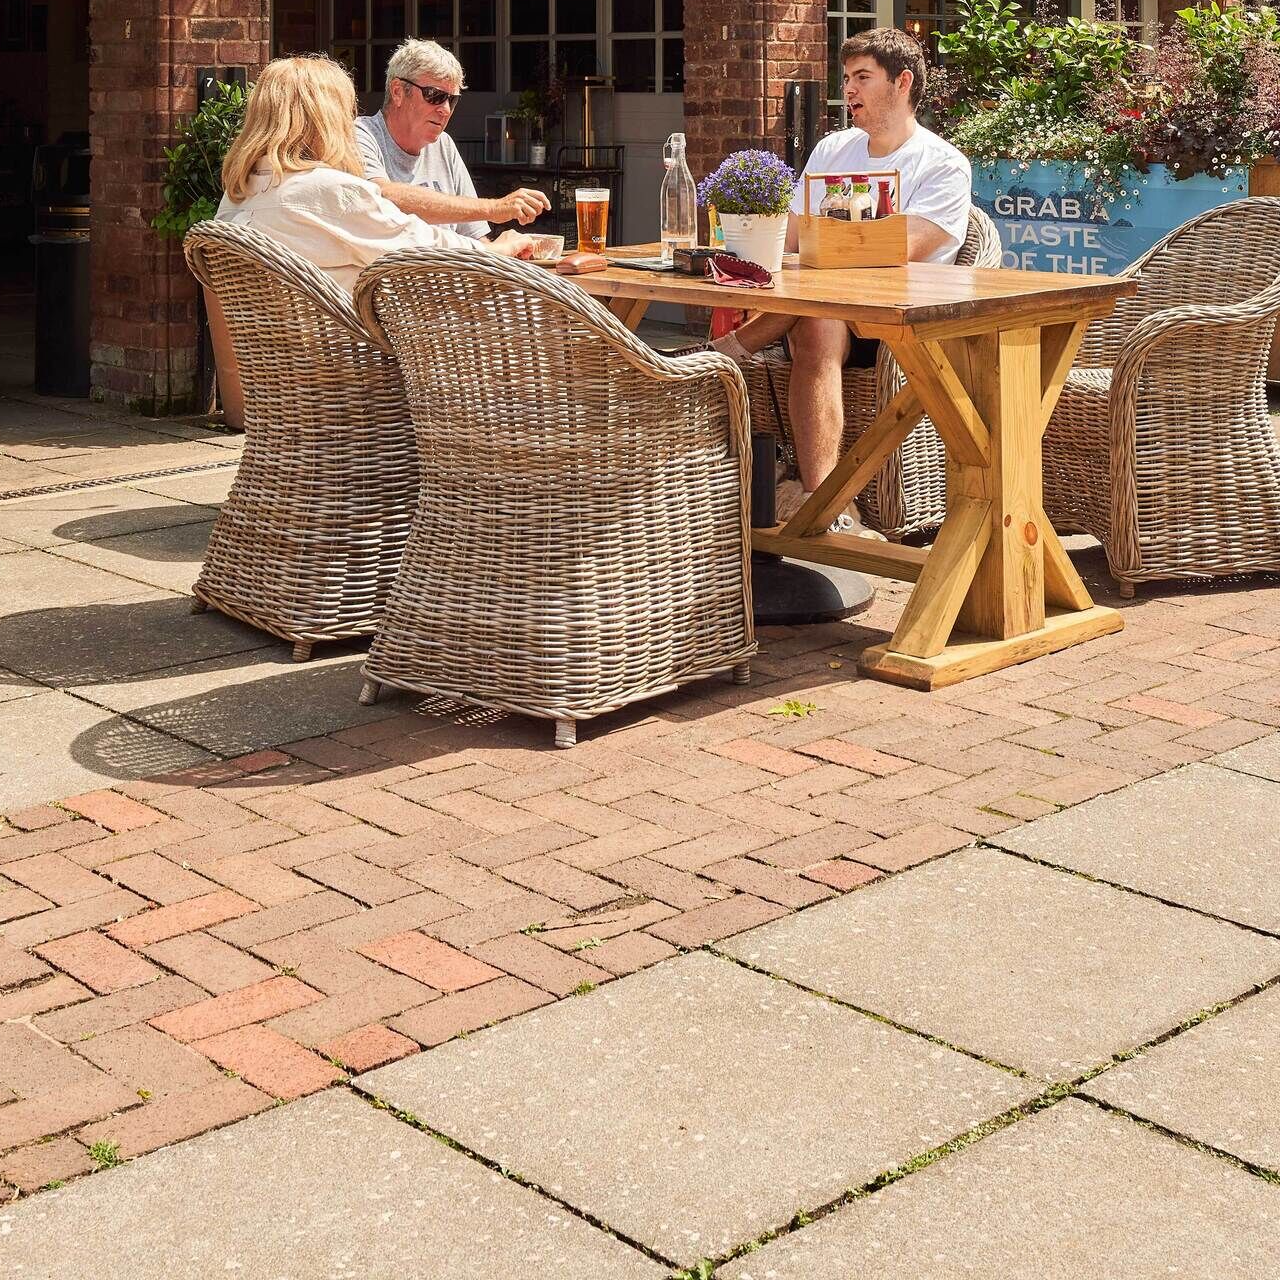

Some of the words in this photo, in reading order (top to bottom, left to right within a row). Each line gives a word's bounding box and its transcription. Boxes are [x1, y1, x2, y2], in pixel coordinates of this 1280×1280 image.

[206, 77, 214, 88] 7
[795, 85, 801, 96] 8
[793, 136, 800, 148] 8
[994, 195, 1081, 219] GRAB
[1089, 199, 1110, 221] A
[1005, 223, 1101, 249] TASTE
[1001, 250, 1037, 272] OF
[1046, 253, 1109, 276] THE
